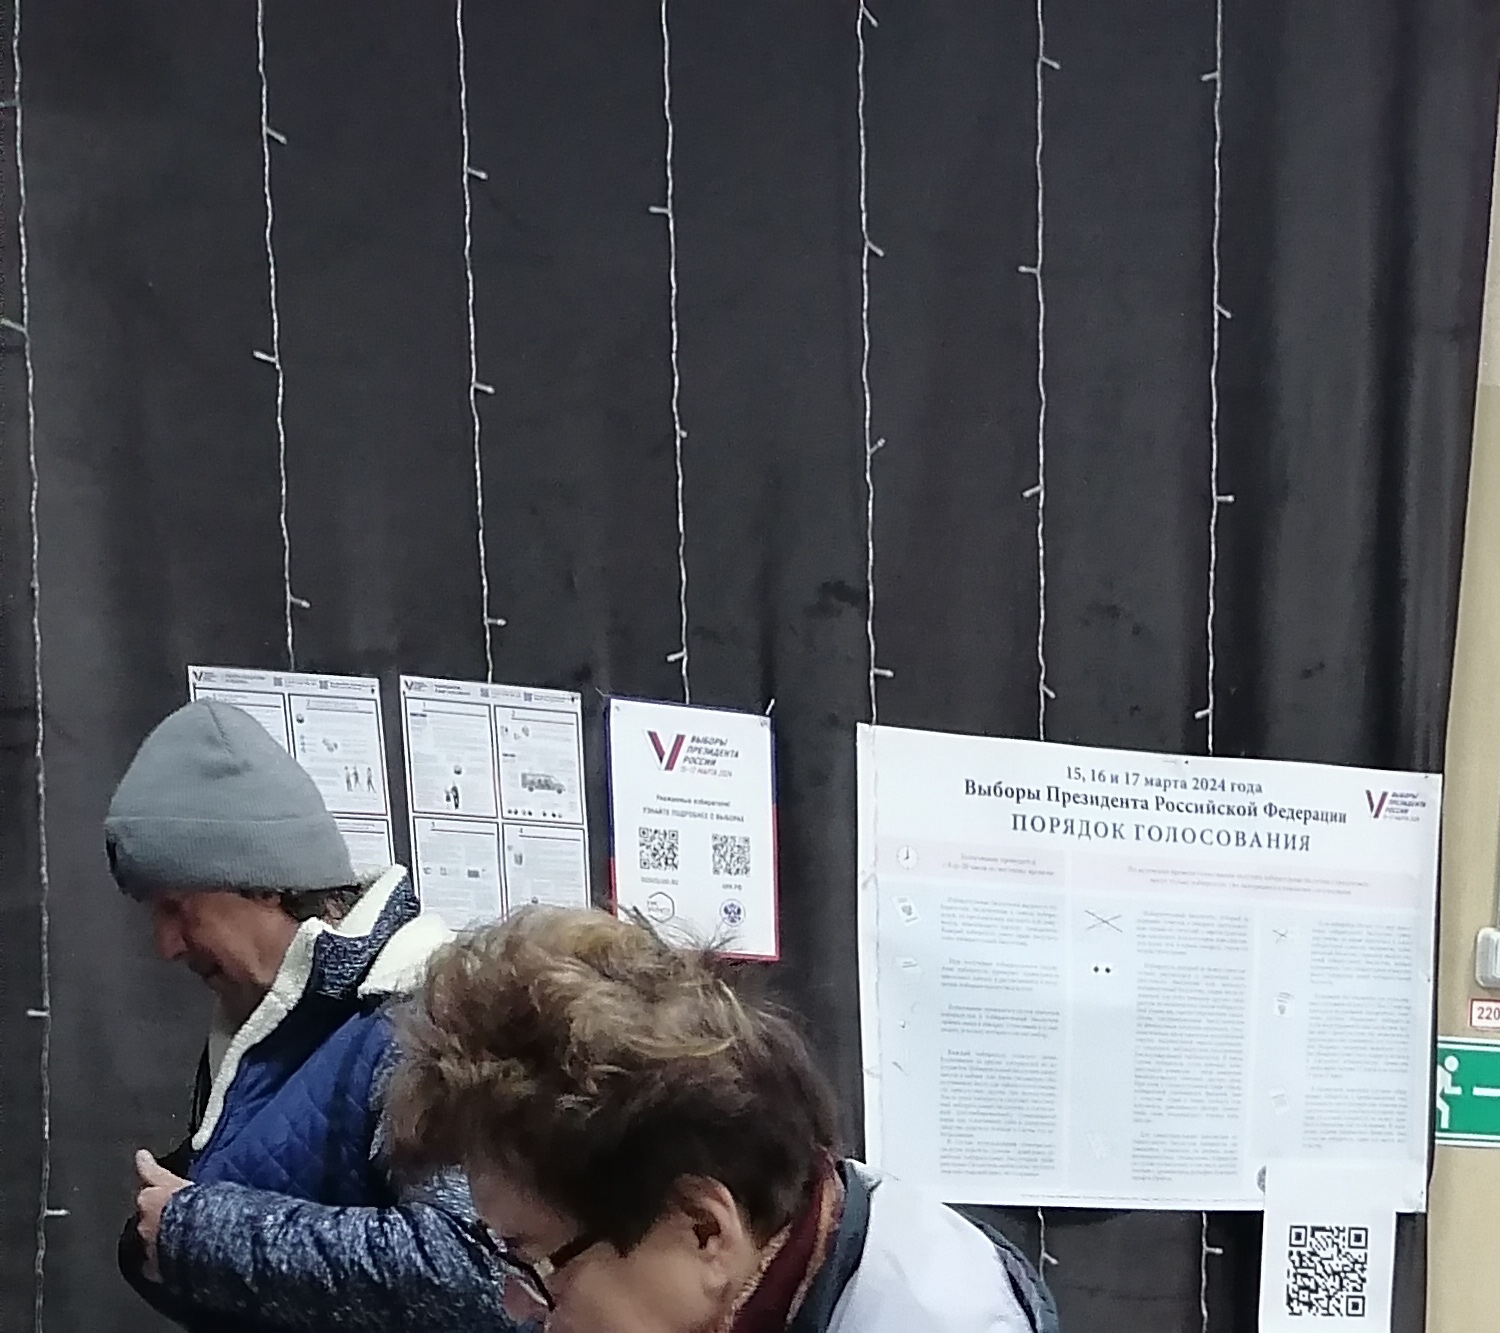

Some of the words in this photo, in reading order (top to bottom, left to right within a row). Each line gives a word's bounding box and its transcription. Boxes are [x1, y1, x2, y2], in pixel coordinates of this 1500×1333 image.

[690, 735, 728, 747] ВЫБОРЫ
[687, 745, 739, 759] ПРЕЗИДЕНТА
[683, 756, 717, 766] РОССИИ
[1066, 765, 1086, 783] 15,
[1090, 768, 1107, 783] 16
[1110, 773, 1120, 785] и
[1124, 771, 1140, 787] 17
[1144, 775, 1189, 793] марта
[1192, 777, 1227, 793] 2024
[1230, 780, 1263, 796] года
[964, 778, 1041, 805] Выборы
[1046, 785, 1150, 811] Президента
[1155, 794, 1258, 818] Российской
[1263, 802, 1347, 826] Федерации
[1011, 812, 1127, 842] ПОРЯДОК
[1133, 823, 1311, 852] ГОЛОСОВАНИЯ
[1477, 1006, 1500, 1021] 220
